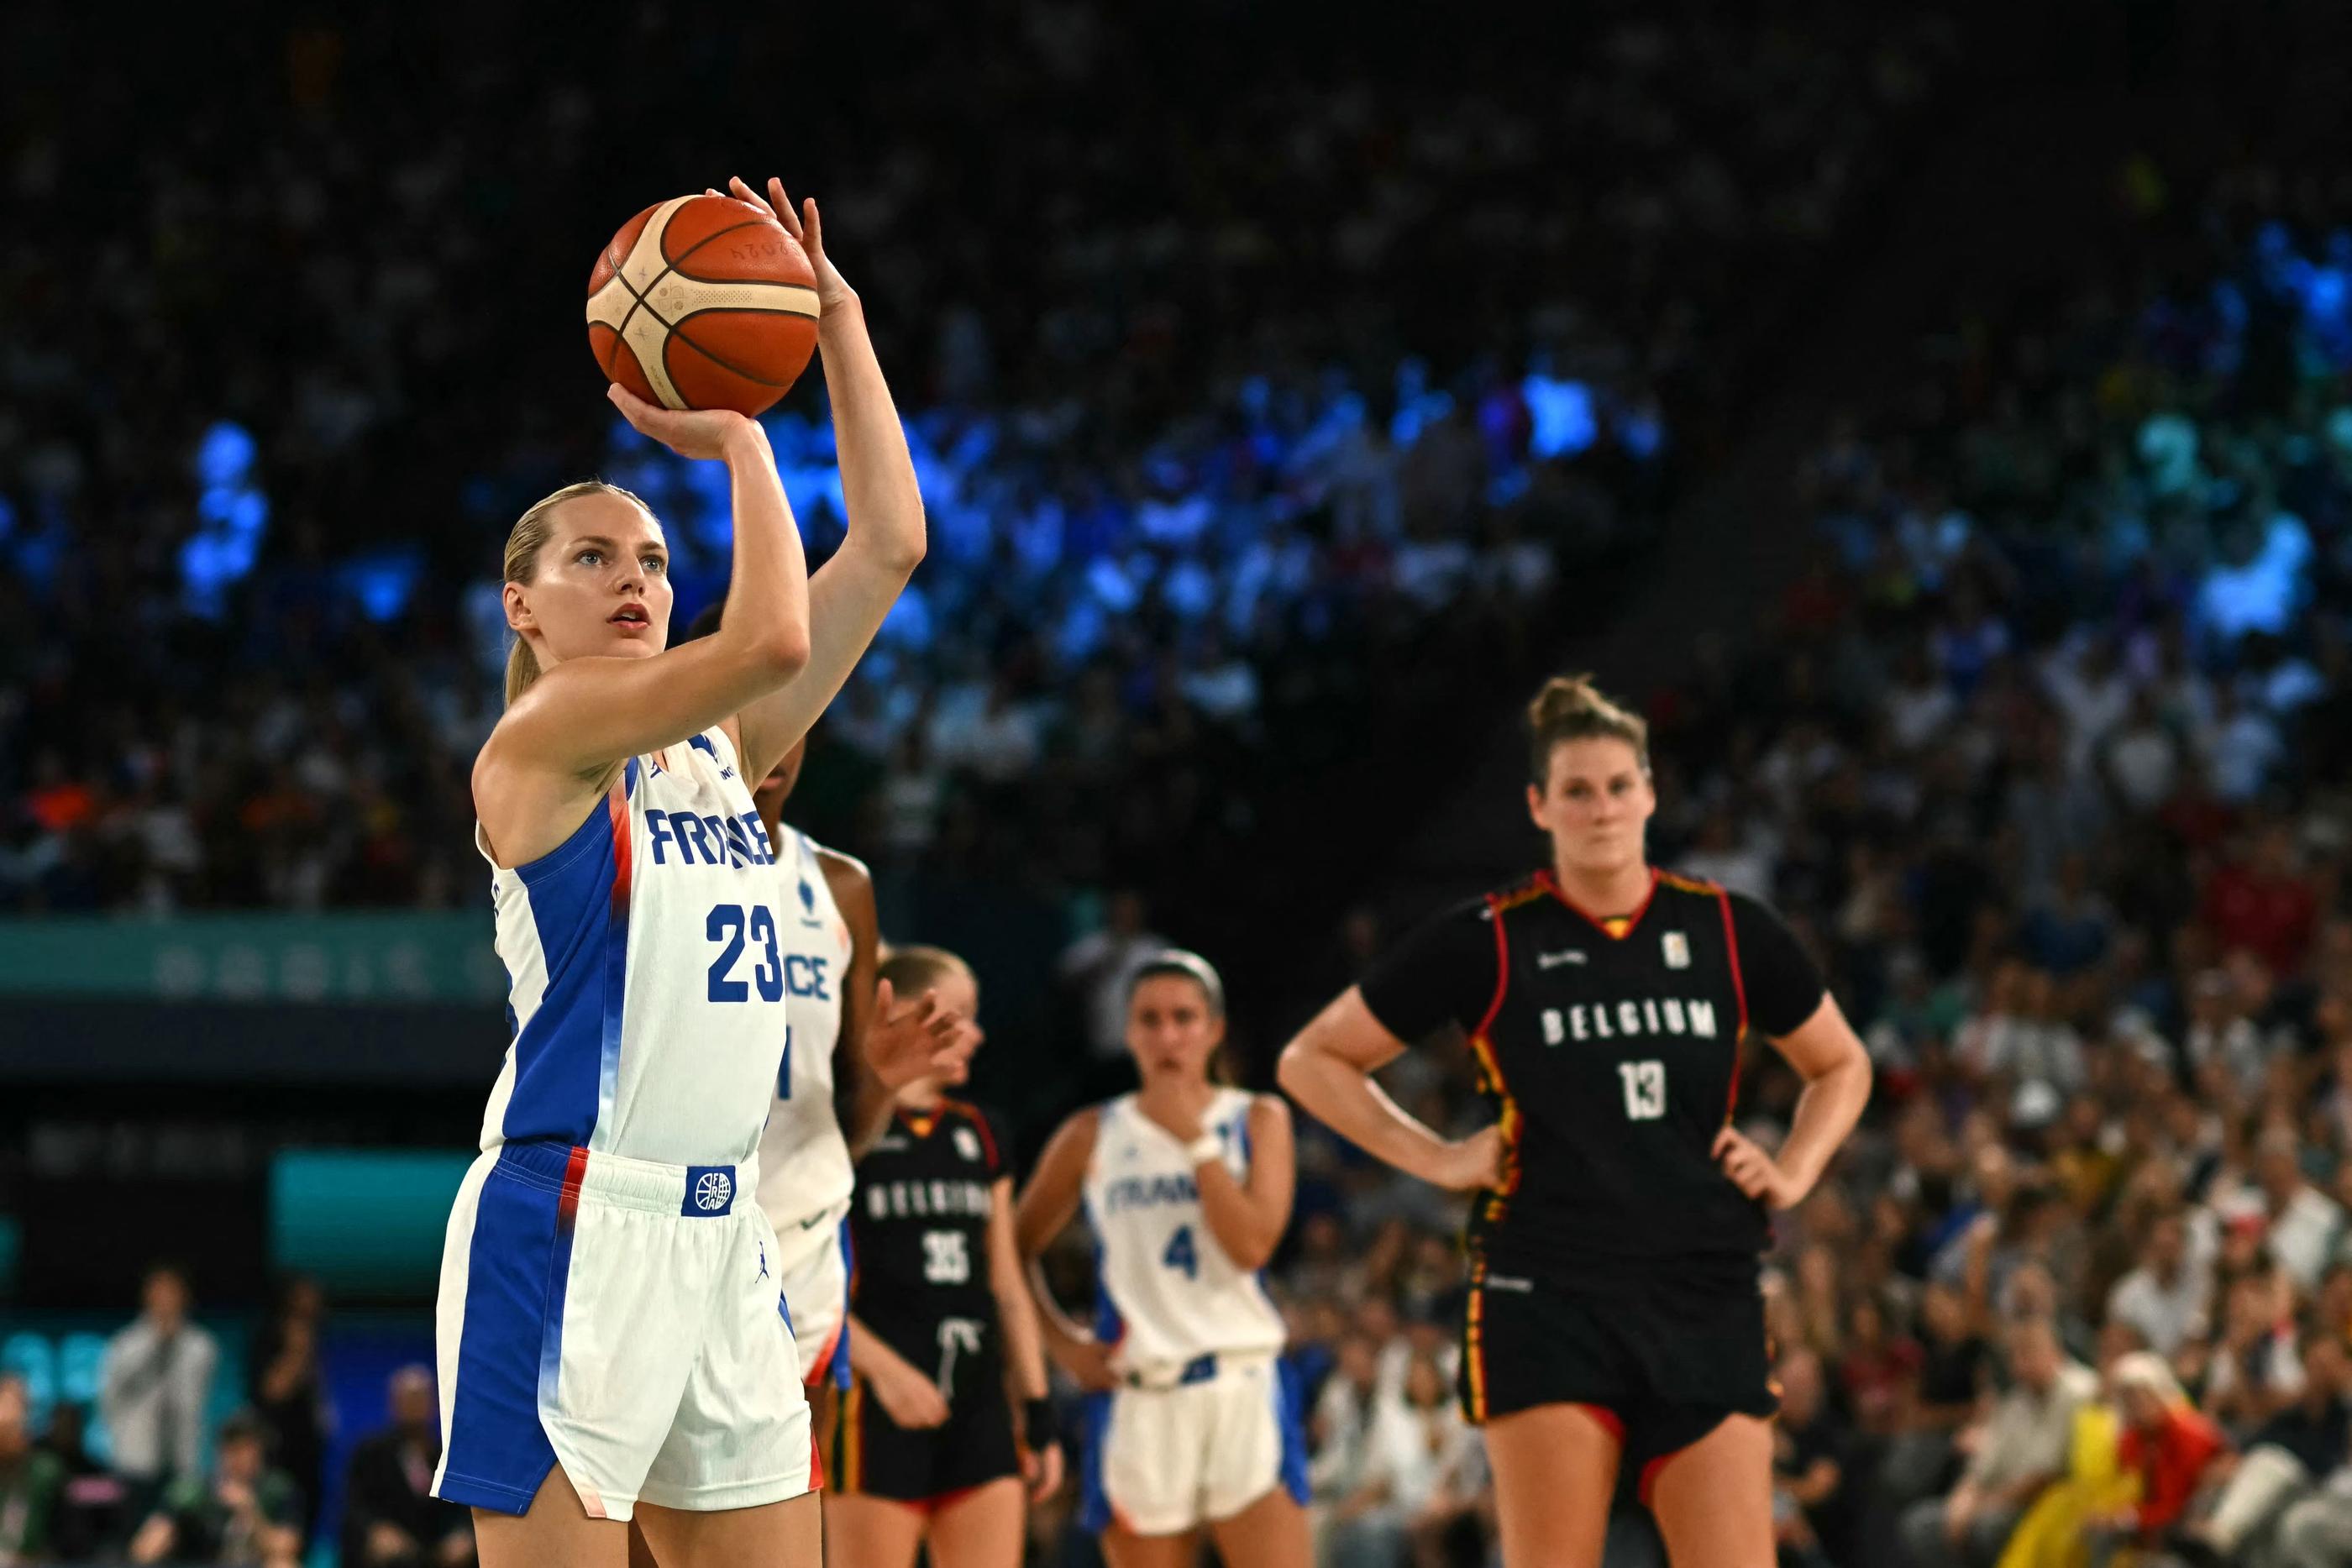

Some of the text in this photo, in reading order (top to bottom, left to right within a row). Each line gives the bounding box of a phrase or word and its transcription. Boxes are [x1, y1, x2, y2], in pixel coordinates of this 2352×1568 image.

[706, 904, 784, 1002] 23
[1541, 998, 1717, 1046] BELGIUM
[1617, 1060, 1666, 1120] 13
[707, 1172, 719, 1210] FRA
[1105, 1174, 1200, 1215] FRAN
[1162, 1224, 1198, 1281] 4
